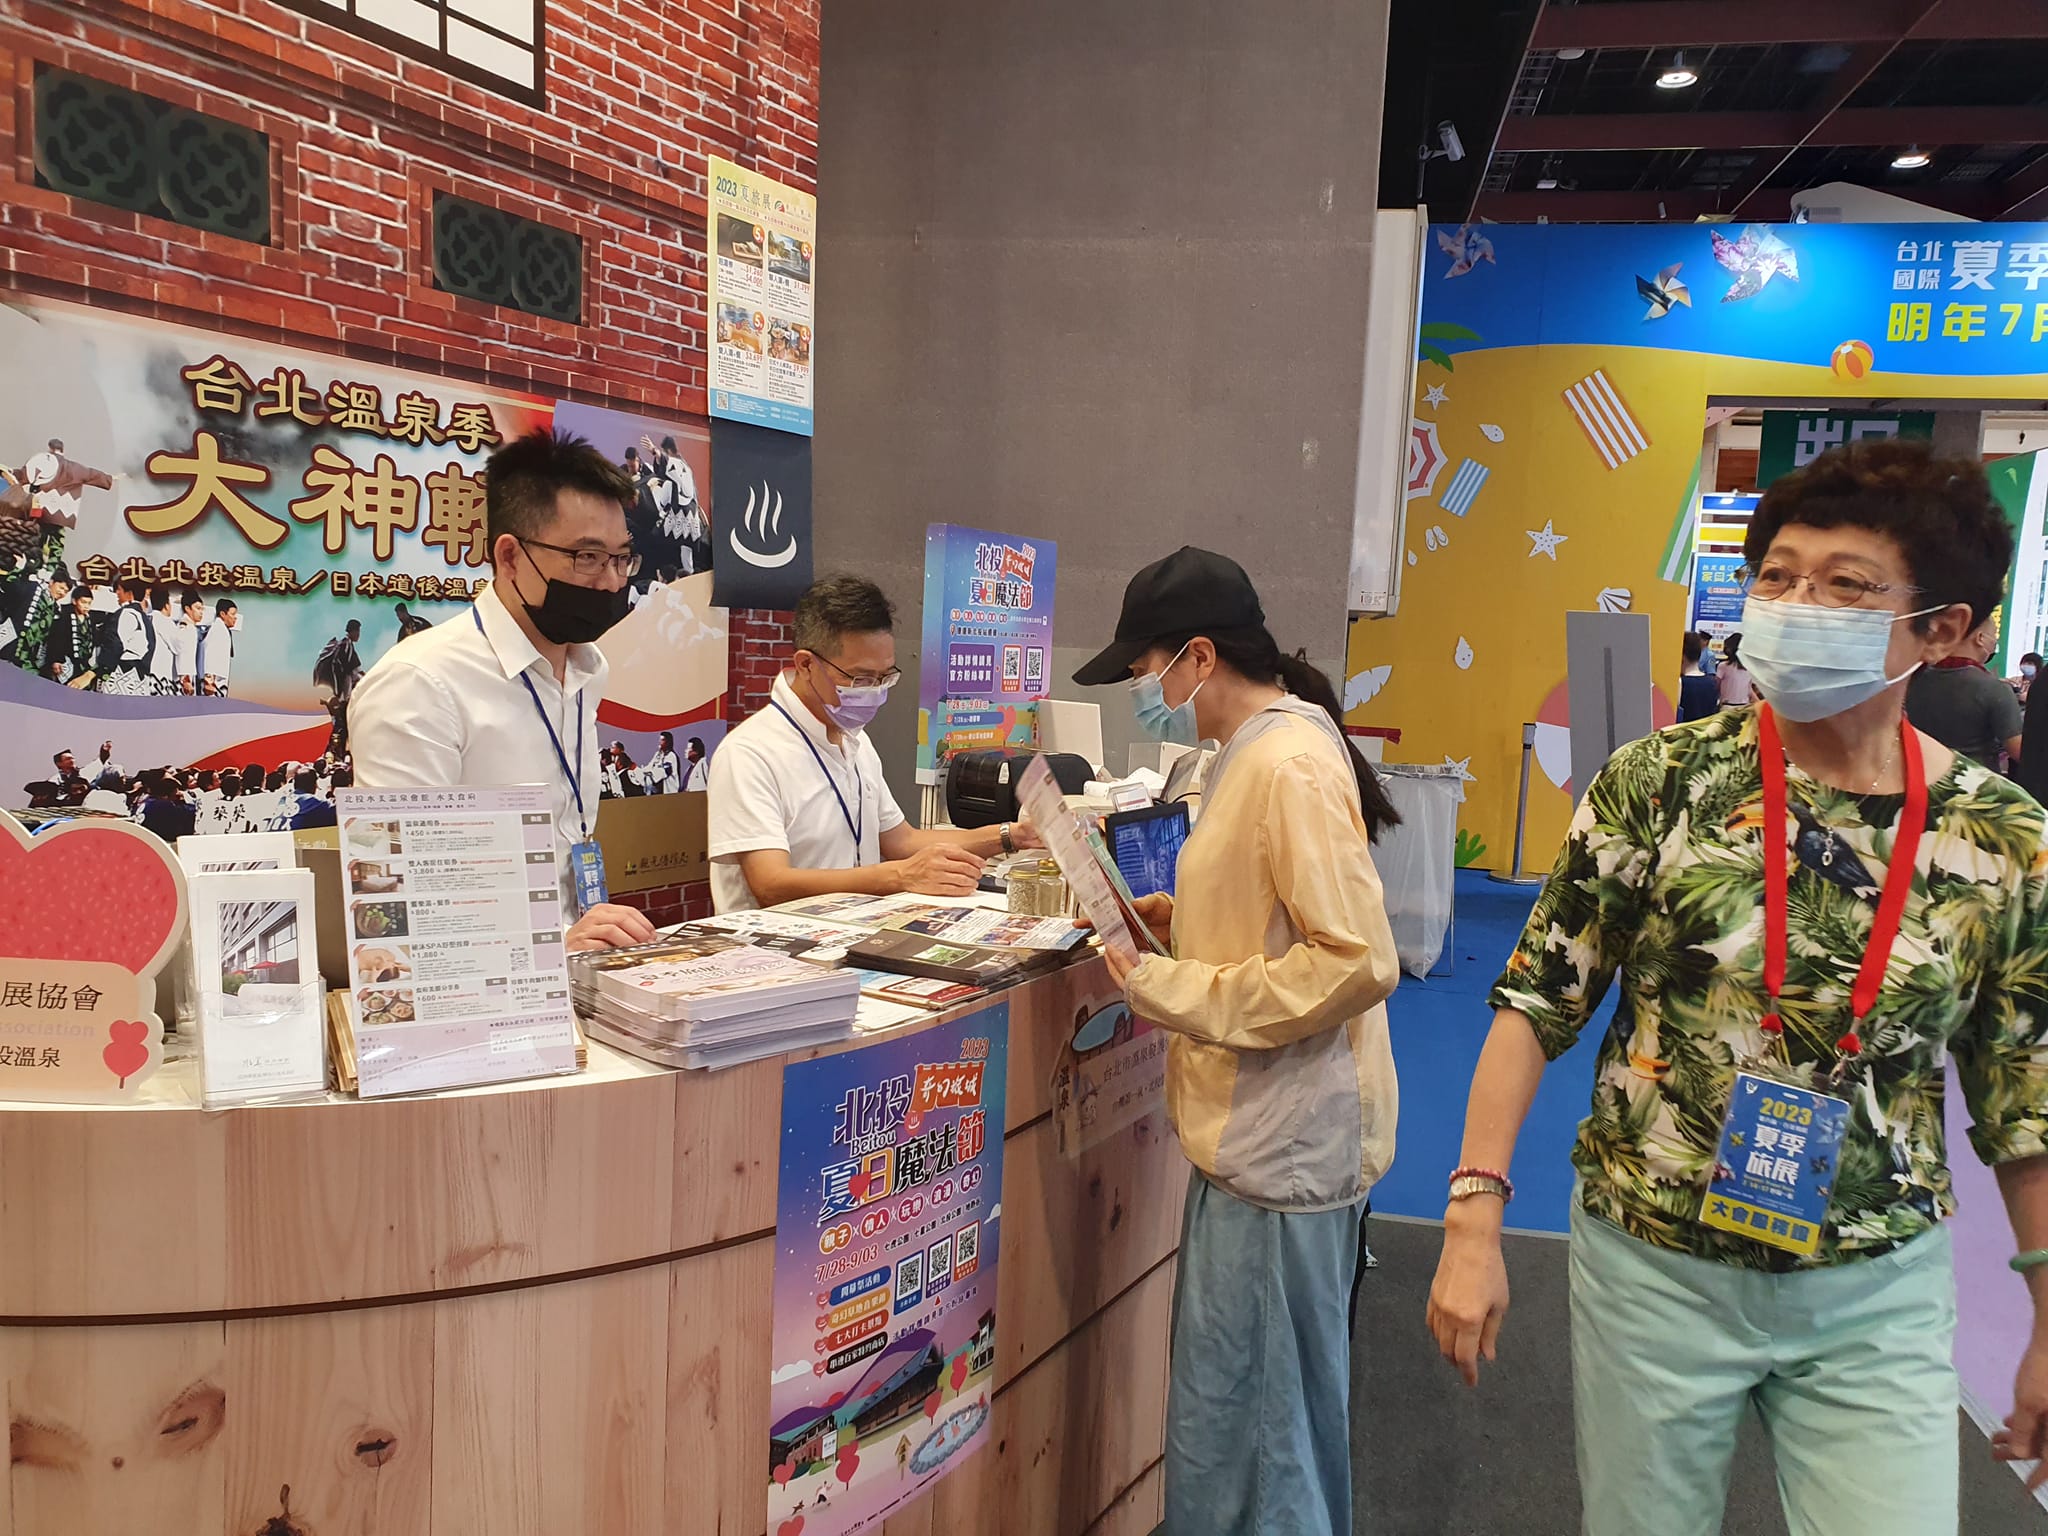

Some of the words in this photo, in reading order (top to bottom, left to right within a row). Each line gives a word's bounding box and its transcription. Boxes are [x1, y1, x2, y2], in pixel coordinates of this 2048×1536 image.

[717, 176, 737, 197] 2023
[1897, 241, 1944, 261] 台北
[1893, 269, 1940, 290] 國際
[181, 354, 502, 453] 台北溫泉季
[975, 544, 1001, 572] 北投
[971, 578, 1033, 609] 夏日魔法節
[1, 981, 103, 1011] 展協會
[960, 1037, 990, 1059] 2023
[833, 1075, 911, 1144] 北投
[1760, 1097, 1813, 1126] 2023
[851, 1130, 896, 1158] Beitou
[1753, 1123, 1806, 1157] 夏季
[818, 1111, 986, 1226] 夏日魔法節
[1745, 1151, 1800, 1186] 旅展
[822, 1227, 849, 1248] 親子
[864, 1213, 888, 1234] 情人
[817, 1244, 878, 1283] 7/28-9/03
